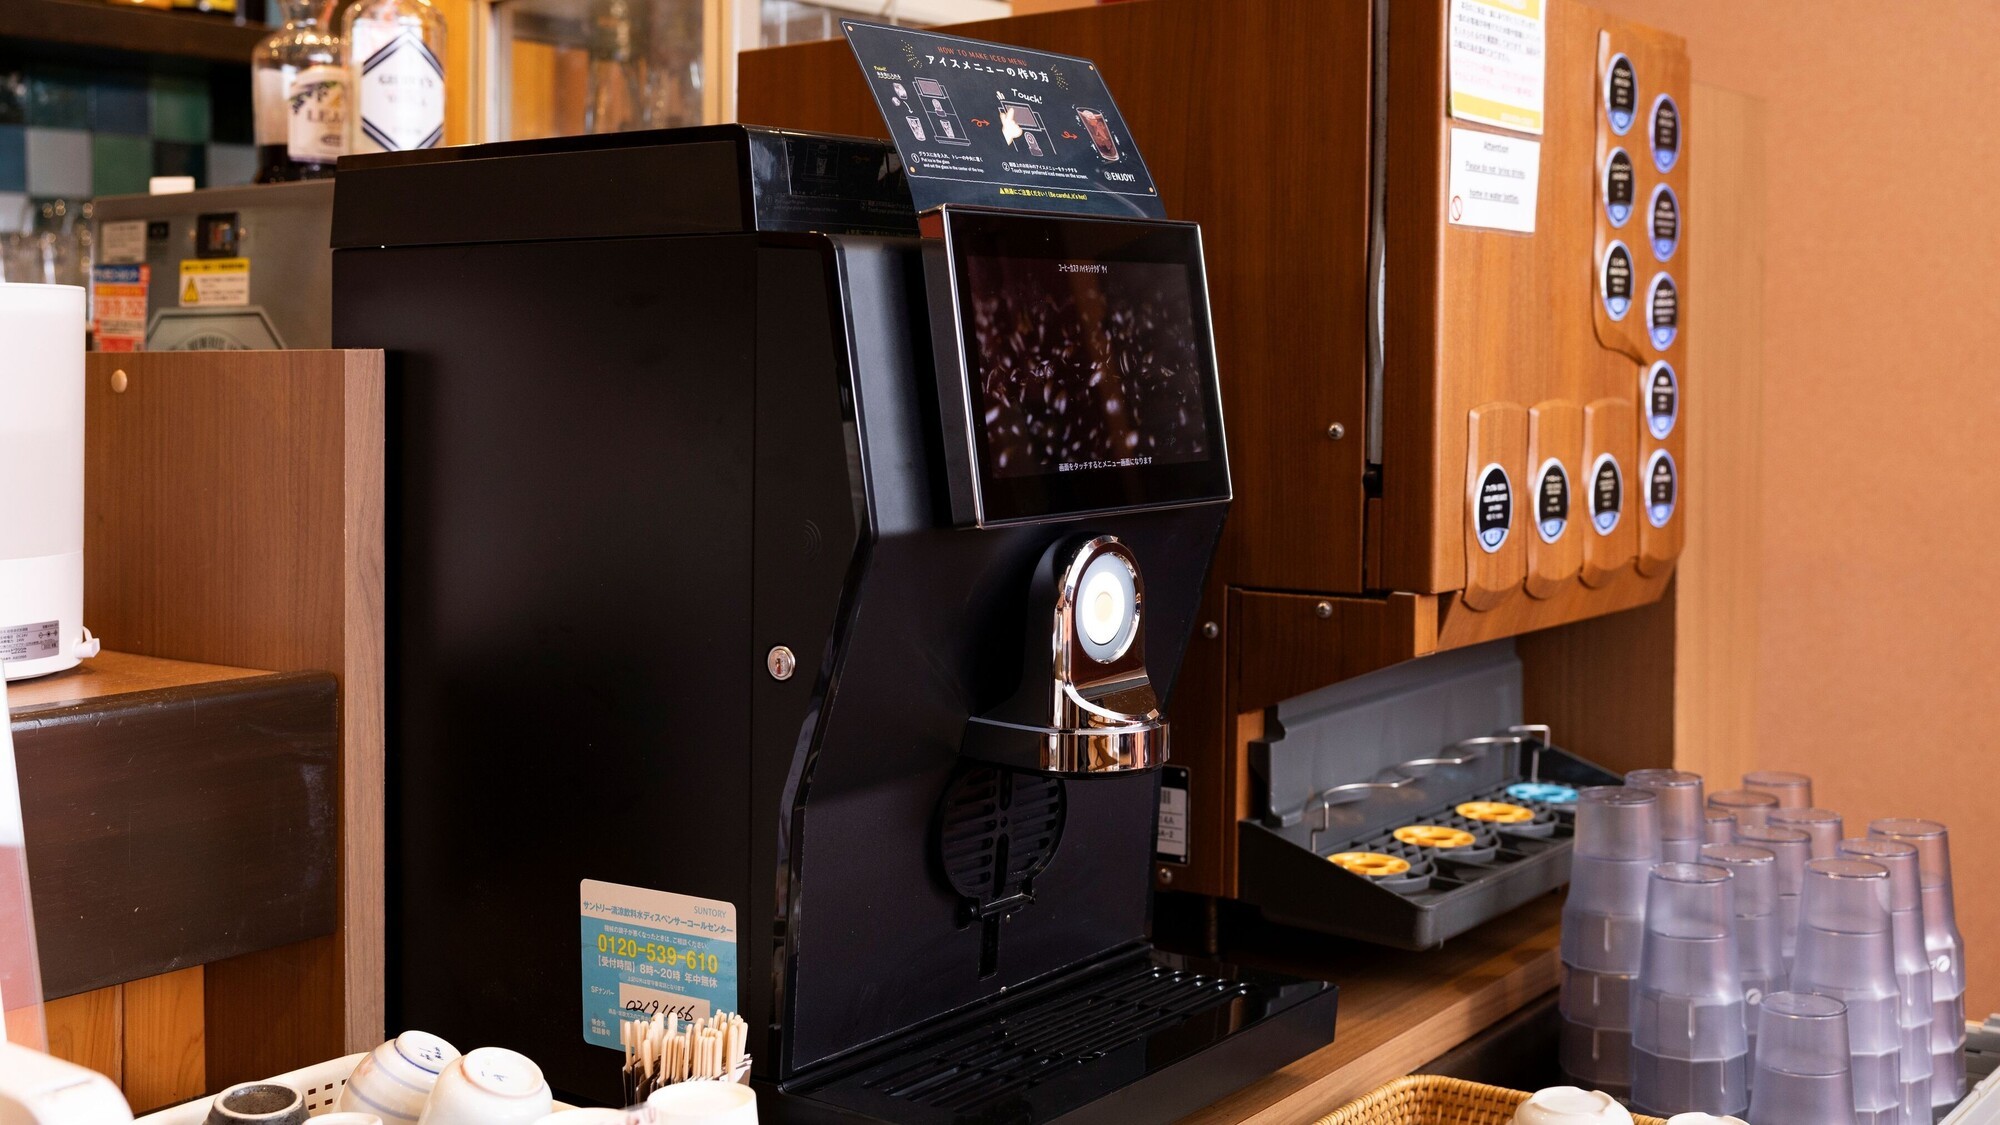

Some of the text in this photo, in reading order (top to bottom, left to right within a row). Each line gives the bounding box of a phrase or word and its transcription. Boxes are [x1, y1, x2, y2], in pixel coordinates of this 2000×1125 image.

[937, 46, 1028, 67] HOW TO MAKE ICED MENU
[925, 54, 1050, 83] アイスメニューの作り方
[1011, 88, 1043, 105] Touch!
[1059, 456, 1152, 472] 画面をタッチするとメニュー画面になります
[583, 901, 734, 934] サントリー清涼飲料水ディスペンサーコールセンター
[693, 905, 727, 918] SUNTORY
[597, 933, 719, 974] 0120-539-610
[684, 973, 718, 989] 年中無休
[590, 985, 615, 996] SFナンバー
